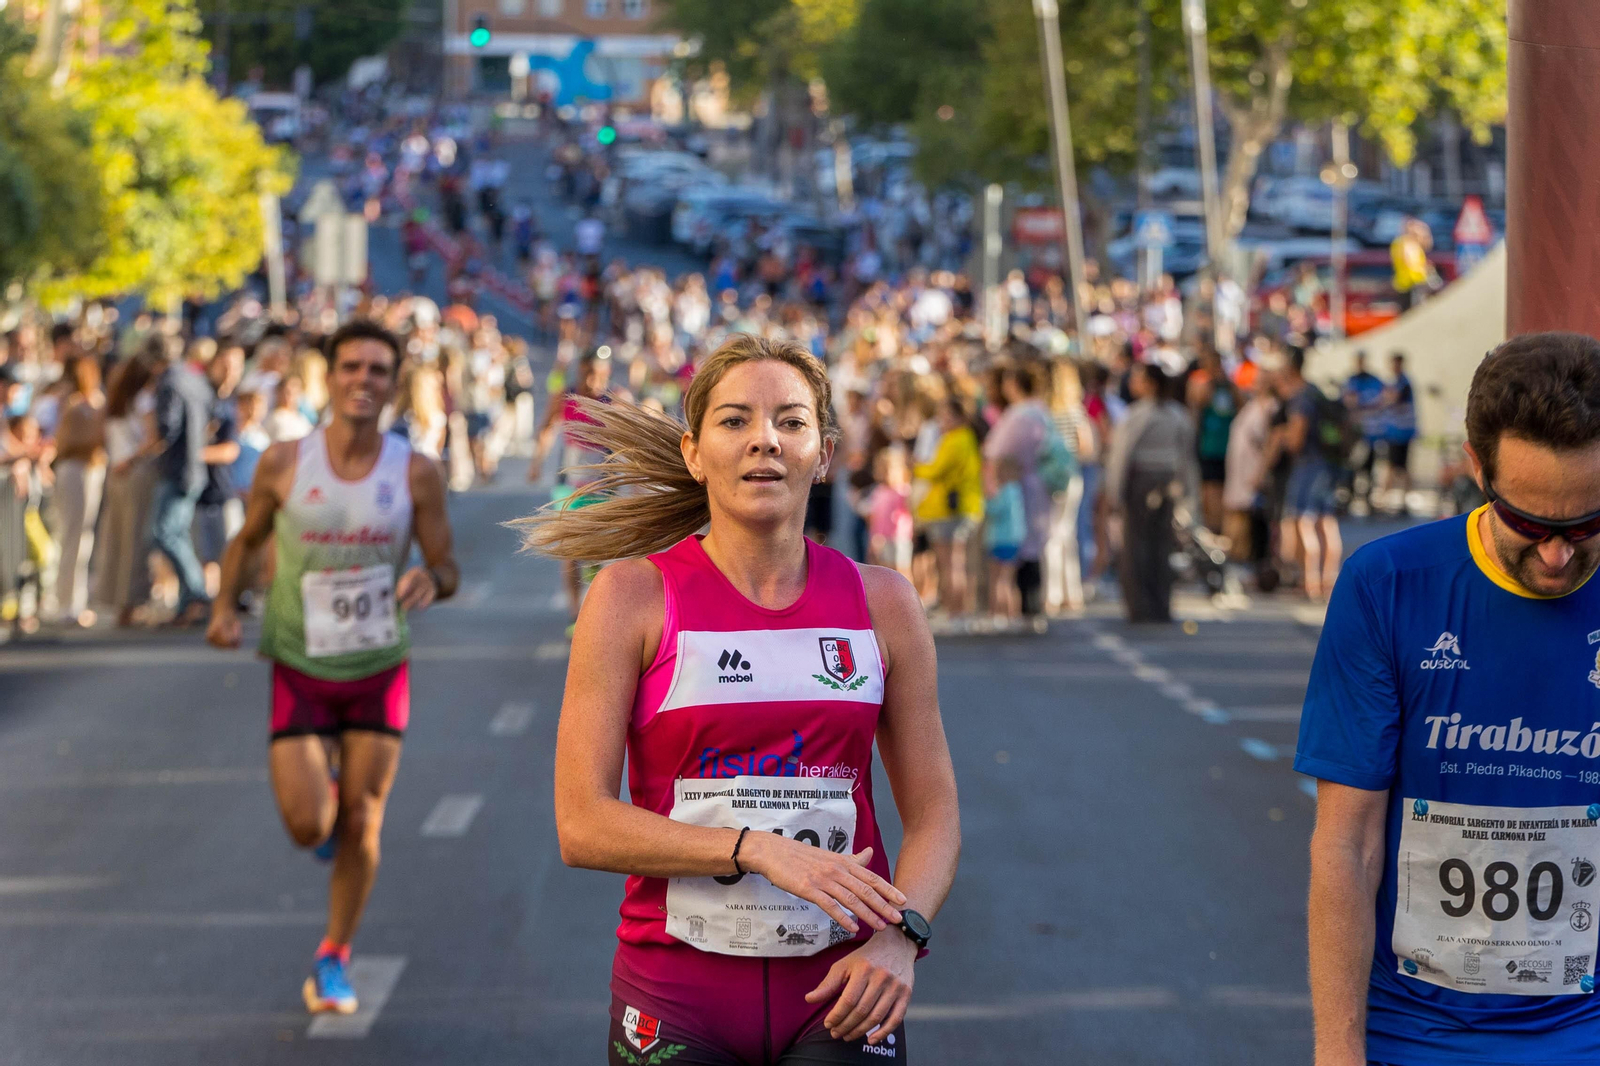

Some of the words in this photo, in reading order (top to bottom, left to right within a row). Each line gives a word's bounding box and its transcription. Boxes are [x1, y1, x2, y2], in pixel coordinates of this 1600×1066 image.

[332, 591, 371, 622] 90
[825, 643, 847, 652] CABC
[718, 673, 753, 683] mobel
[698, 746, 782, 778] fisio
[799, 761, 858, 780] herakles
[1439, 761, 1461, 774] Est.
[1465, 762, 1504, 776] Piedra
[1507, 764, 1562, 780] Pikachos
[684, 791, 702, 800] XXXV
[703, 788, 735, 800] MEMORIAL
[736, 788, 771, 799] SARGENTO
[772, 789, 782, 798] DE
[784, 788, 821, 799] INFANTERÍA
[822, 790, 828, 799] DE
[829, 790, 848, 799] MARINA
[732, 800, 757, 809] RAFAEL
[759, 800, 790, 810] CARMONA
[793, 800, 810, 810] PÁEZ
[1430, 814, 1465, 826] MEMORIAL
[1467, 818, 1505, 828] SARGENTO
[1507, 819, 1517, 829] DE
[1519, 818, 1559, 829] INFANTERÍA
[1561, 819, 1570, 828] DE
[1571, 818, 1597, 828] MARINA
[1462, 830, 1489, 840] RAFAEL
[1491, 831, 1526, 841] CARMONA
[1528, 831, 1546, 842] PÁEZ
[1438, 858, 1564, 921] 980
[1457, 937, 1490, 946] ANTONIO
[1518, 960, 1552, 968] RECOSUR
[625, 1012, 654, 1030] CABC
[862, 1044, 896, 1058] mobel
